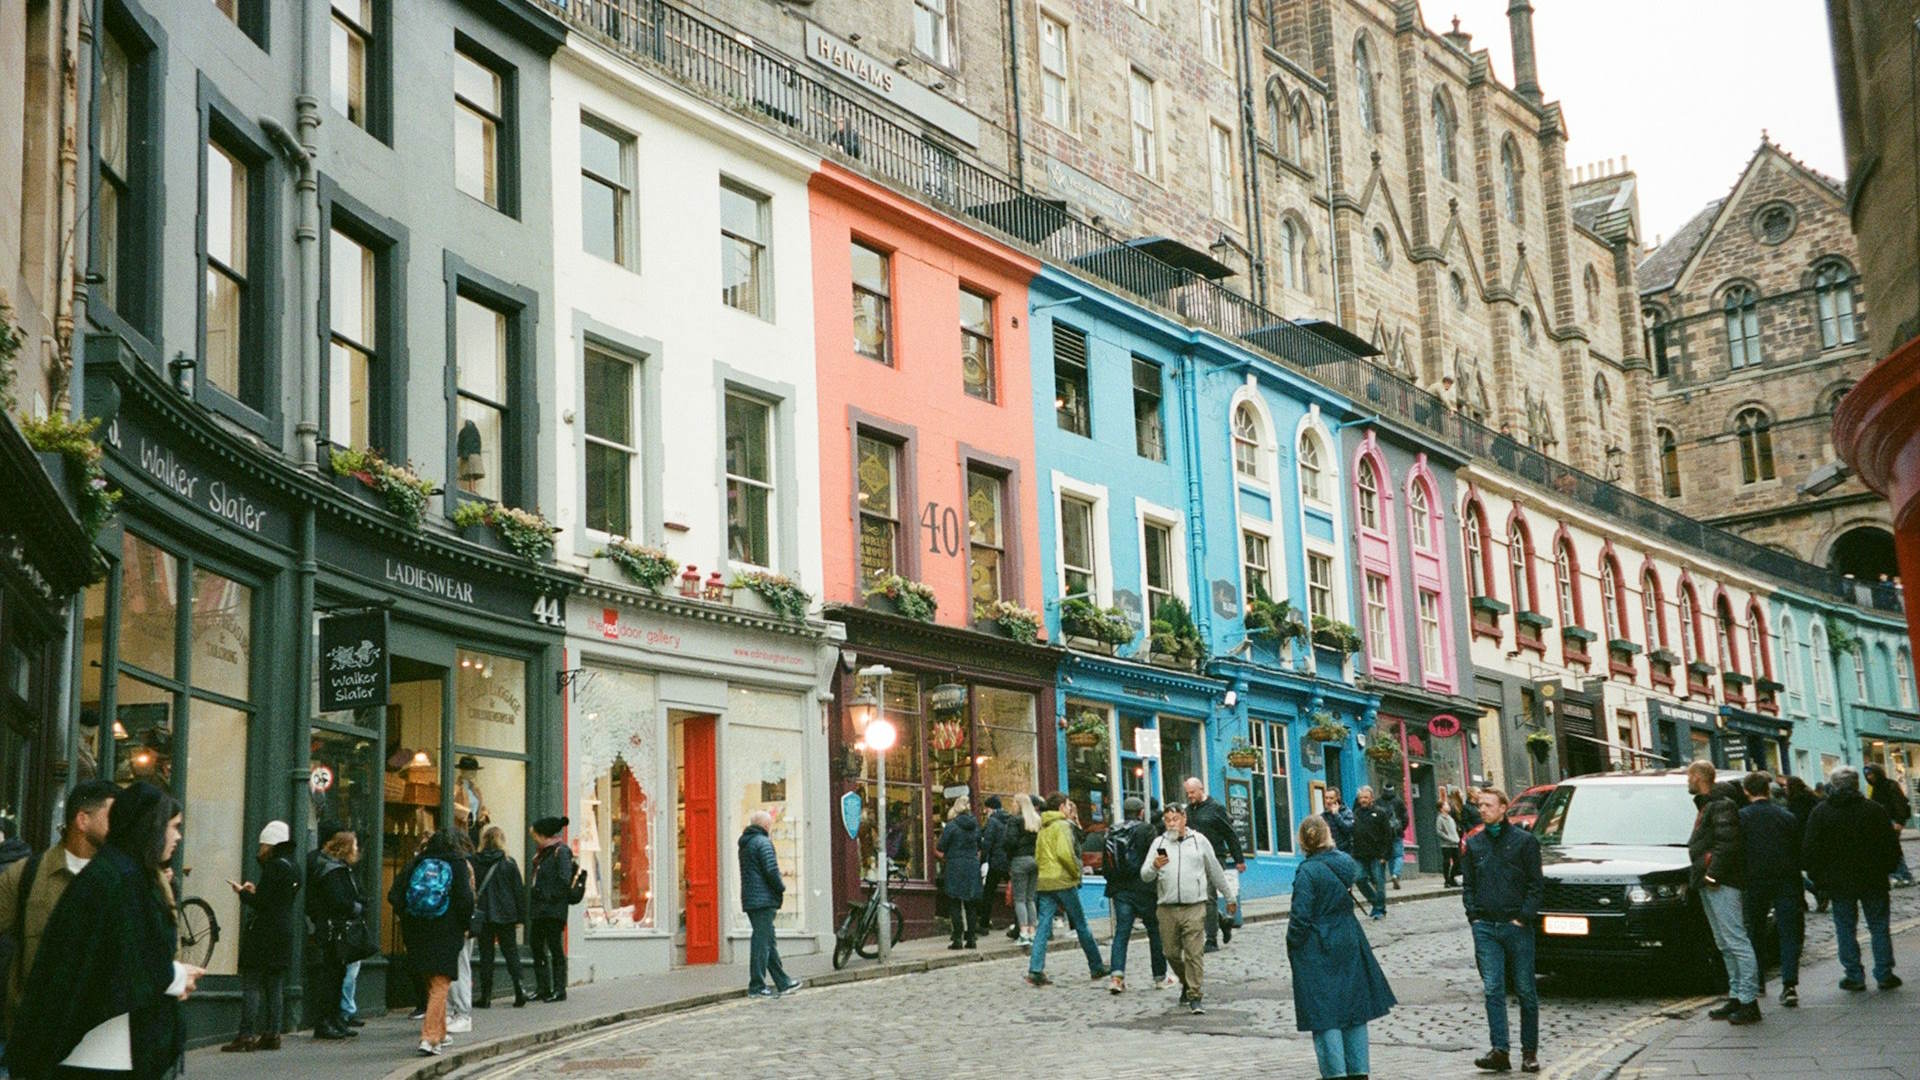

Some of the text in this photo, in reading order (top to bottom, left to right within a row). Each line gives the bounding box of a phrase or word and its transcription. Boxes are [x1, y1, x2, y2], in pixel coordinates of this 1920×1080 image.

[141, 437, 266, 532] Walker Slater
[920, 502, 959, 557] 40
[385, 558, 474, 603] LADIESWEAR
[620, 621, 642, 639] door
[647, 627, 681, 649] gallery
[335, 686, 375, 702] Slater
